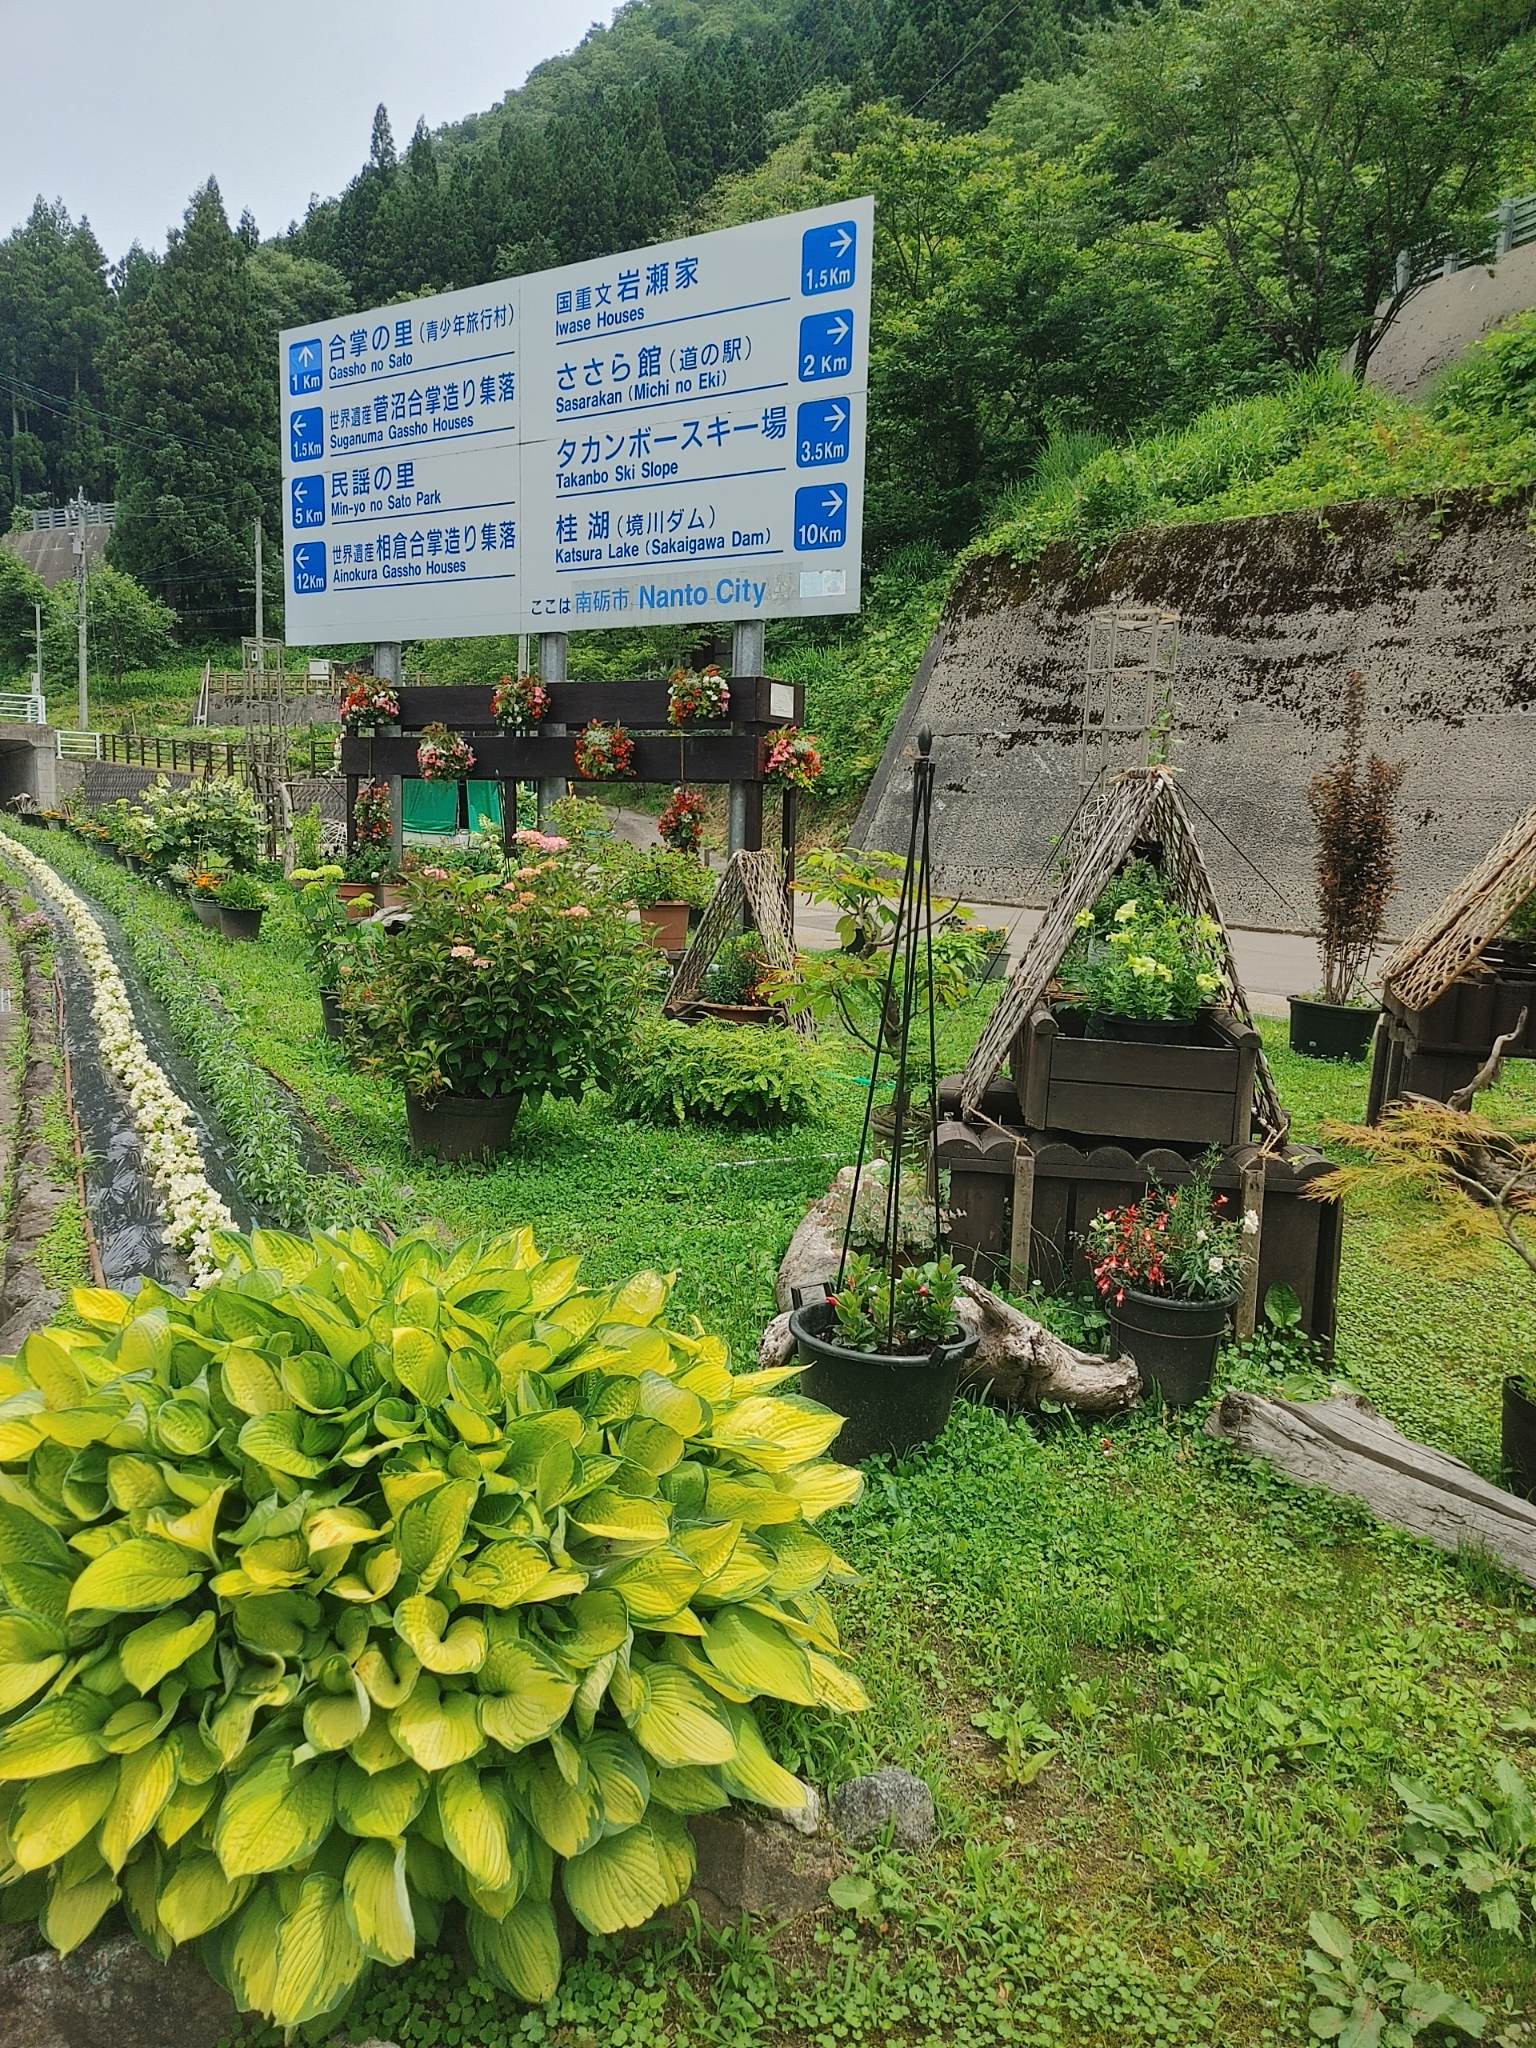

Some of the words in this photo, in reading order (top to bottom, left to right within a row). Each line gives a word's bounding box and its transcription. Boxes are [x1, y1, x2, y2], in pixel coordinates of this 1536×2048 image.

[556, 257, 698, 315] 国重文岩瀬家
[806, 267, 850, 290] 1.5Km
[556, 318, 591, 336] Iwase
[597, 307, 644, 328] Houses
[329, 362, 366, 381] Gassho
[371, 359, 384, 373] no
[389, 352, 413, 369] Sato
[804, 354, 815, 376] 2
[821, 355, 847, 374] Km
[303, 374, 320, 390] Km
[556, 391, 622, 413] Sasarakan
[629, 379, 669, 401] (Michi
[675, 379, 692, 394] no
[700, 370, 727, 389] Eki)
[330, 429, 383, 449] Suganuma
[389, 422, 428, 440] Gassho
[433, 414, 474, 433] Houses
[557, 406, 787, 468] タカンボースキー場
[294, 441, 321, 458] 1.5Km
[801, 441, 844, 462] 3.5Km
[331, 462, 415, 498] 民謡の里
[556, 469, 608, 489] Takanbo
[615, 464, 635, 481] Ski
[641, 461, 678, 479] Slope
[295, 510, 302, 524] 5
[306, 508, 323, 523] Km
[332, 500, 365, 517] Min-yo
[370, 497, 383, 512] no
[388, 494, 411, 510] Sato
[416, 490, 441, 506] Park
[556, 547, 602, 564] Katsura
[608, 543, 639, 559] Lake
[645, 535, 725, 555] (Sakaigawa
[732, 528, 771, 547] Dam)
[799, 523, 841, 544] 10Km
[296, 572, 324, 590] 12Km
[333, 566, 378, 583] Ainokura
[382, 562, 421, 579] Gassho
[426, 559, 466, 575] Houses
[639, 583, 708, 610] Nanto
[716, 577, 767, 608] City
